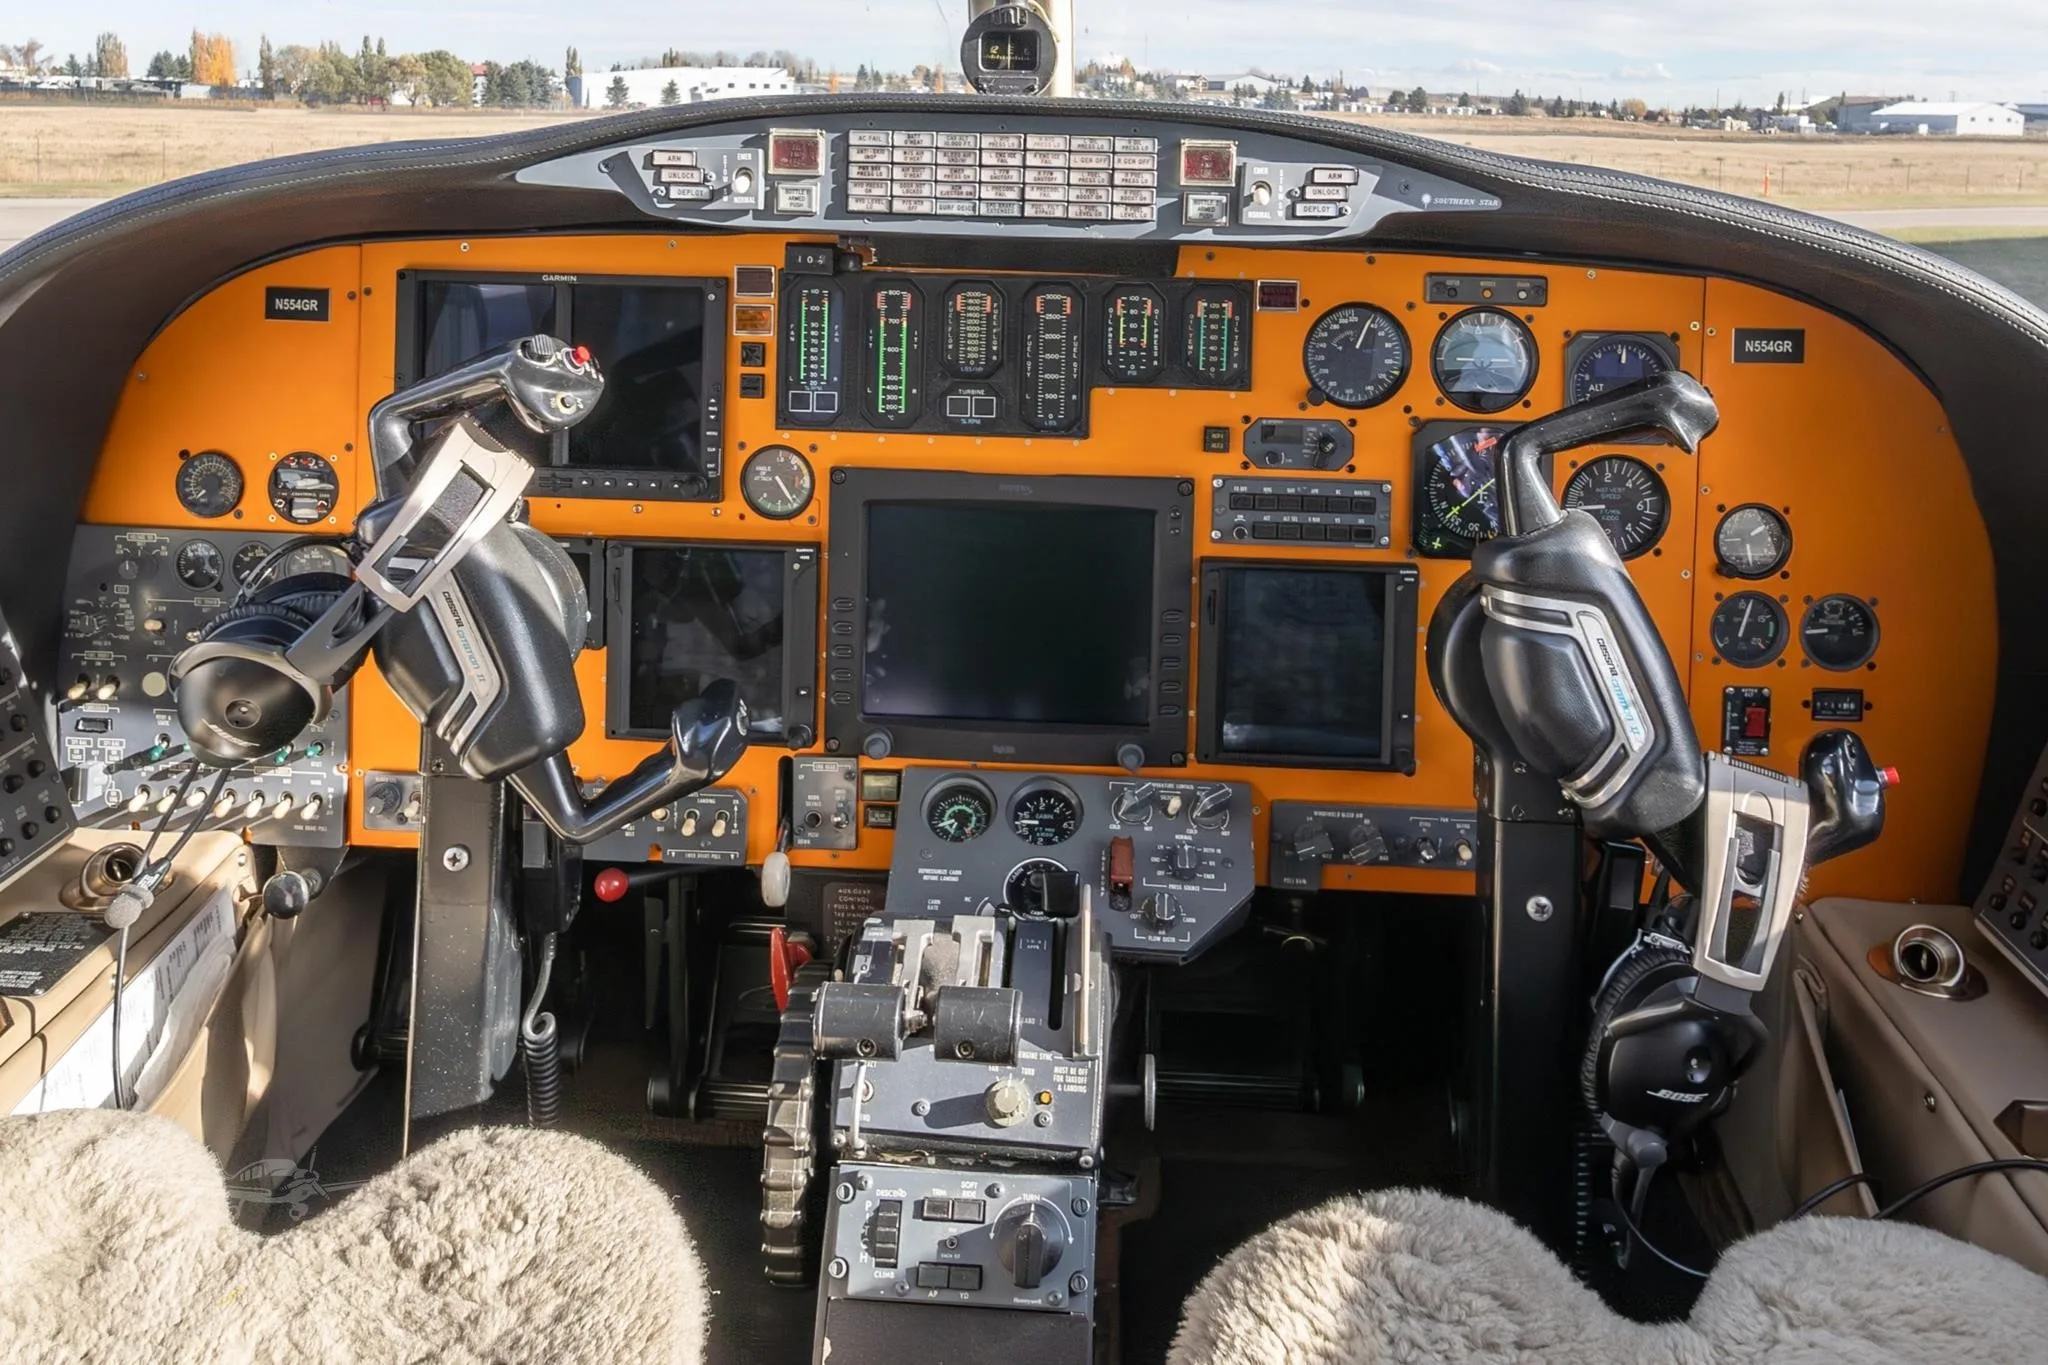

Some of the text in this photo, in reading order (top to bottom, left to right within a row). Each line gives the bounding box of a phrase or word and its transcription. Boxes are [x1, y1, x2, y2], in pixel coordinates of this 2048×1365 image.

[1433, 198, 1475, 206] SOUTHERN
[275, 298, 318, 312] N554GR
[1745, 340, 1792, 353] N554GR
[1588, 383, 1604, 392] ALT
[1604, 472, 1612, 483] 2
[1626, 479, 1633, 488] 4
[1636, 500, 1644, 510] 6
[1626, 523, 1632, 532] 4
[442, 591, 464, 627] cessna
[1758, 615, 1766, 623] 15
[1596, 638, 1618, 676] cessna
[1009, 868, 1024, 883] CABIN
[1018, 1052, 1038, 1060] ENGINE
[1065, 1076, 1088, 1084] TAKEOFF
[1652, 1089, 1706, 1102] BOSE
[859, 1200, 871, 1264] PITCH
